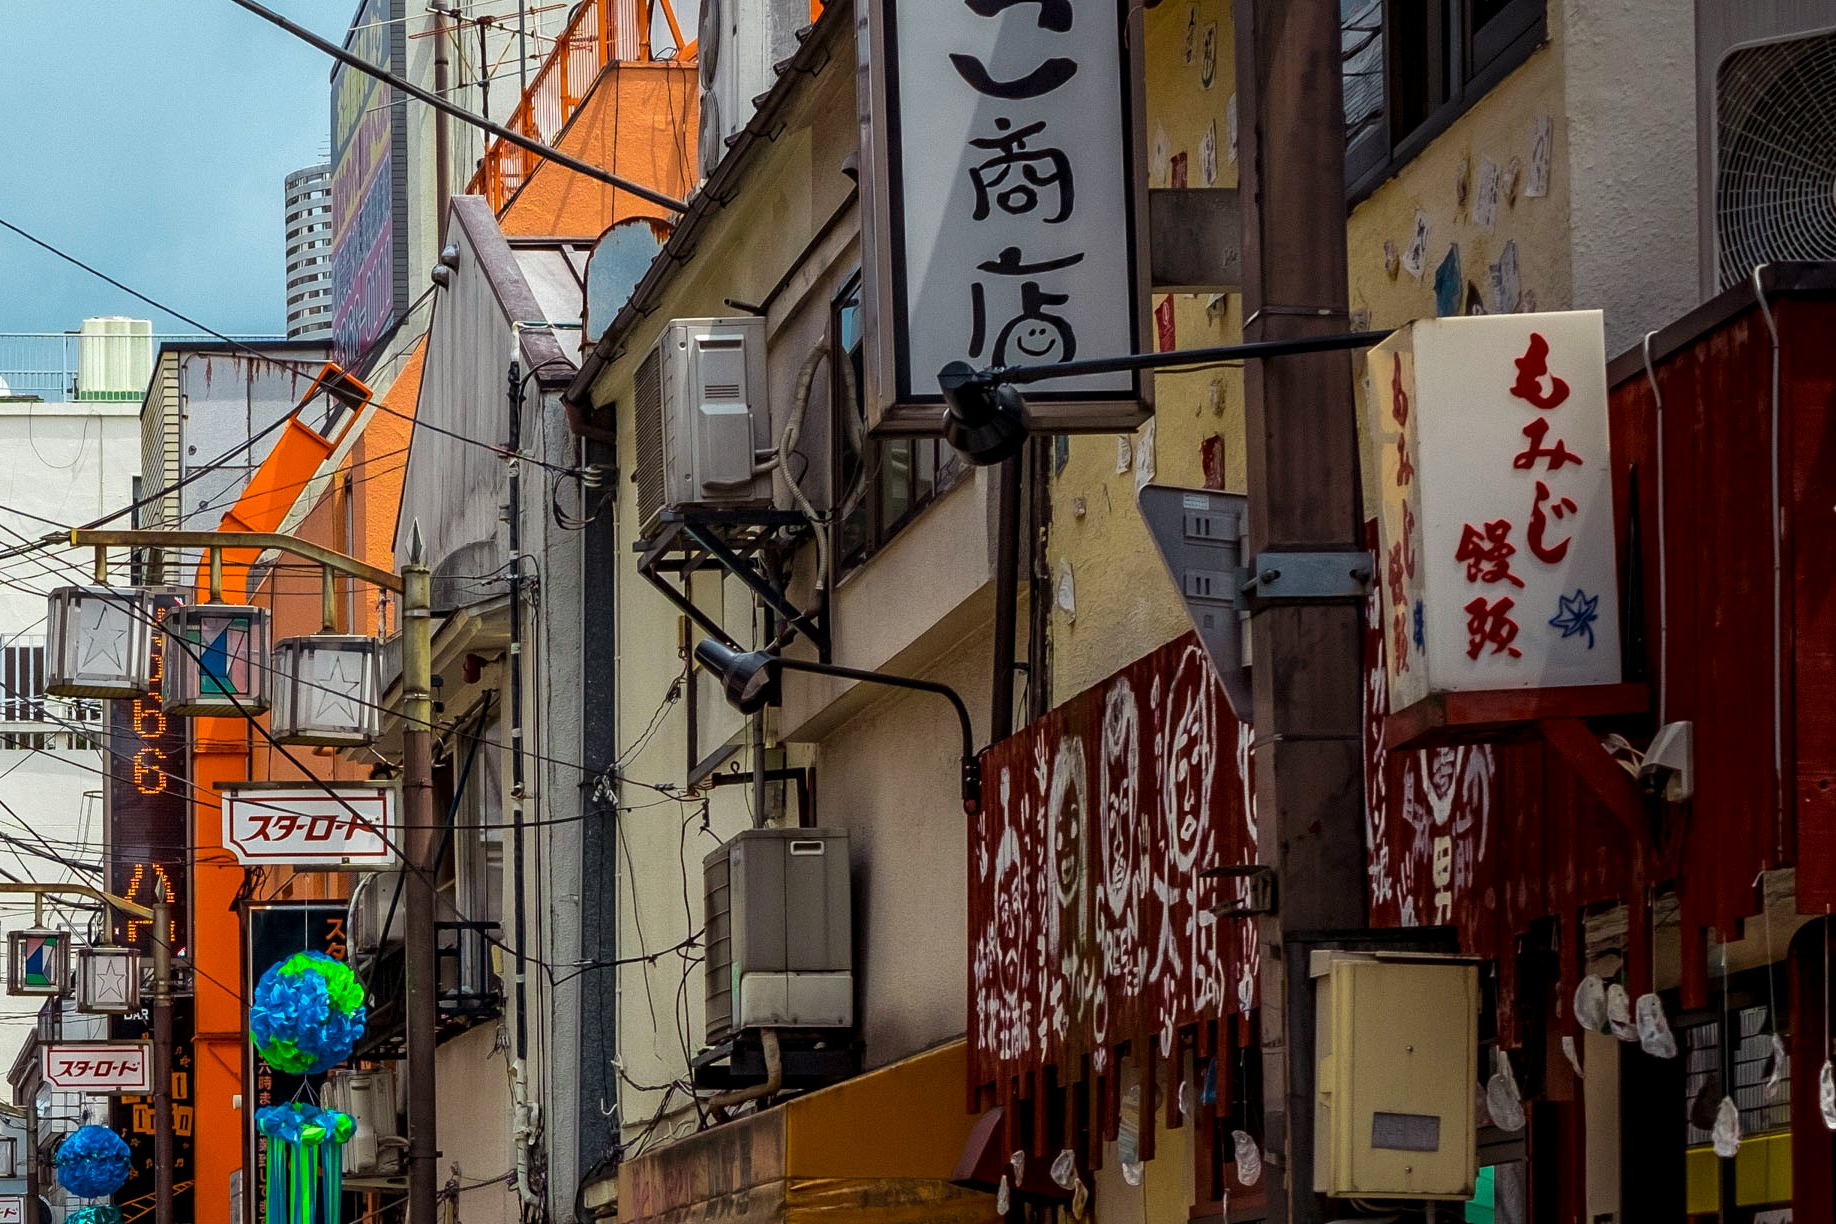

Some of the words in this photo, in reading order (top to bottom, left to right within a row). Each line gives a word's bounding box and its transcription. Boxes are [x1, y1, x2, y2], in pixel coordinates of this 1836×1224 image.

[1509, 332, 1583, 564] もみじ
[1455, 519, 1525, 660] 饅頭
[242, 814, 381, 843] スターロード
[54, 1060, 140, 1078] スターロード
